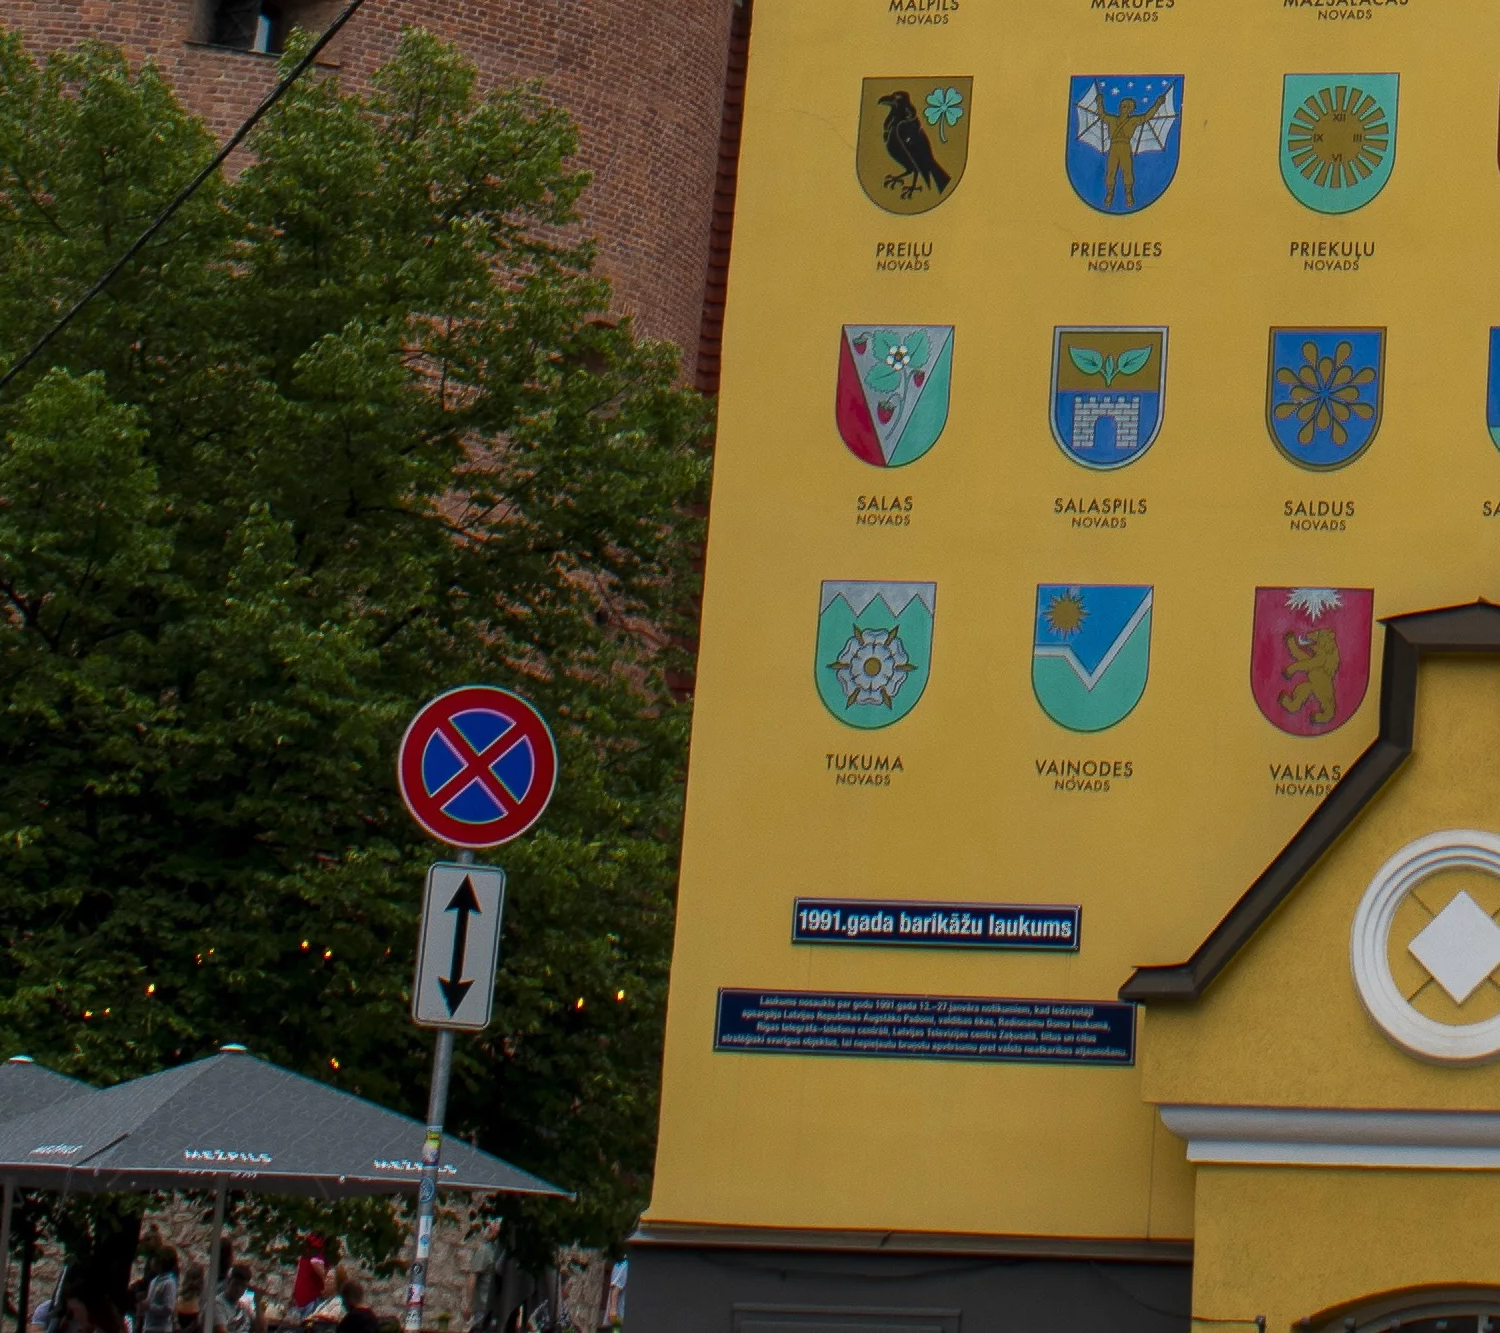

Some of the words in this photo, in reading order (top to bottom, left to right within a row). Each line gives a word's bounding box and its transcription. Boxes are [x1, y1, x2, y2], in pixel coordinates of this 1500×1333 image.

[875, 241, 933, 262] PREIĻU
[1070, 241, 1163, 258] PRIEKULES
[1289, 241, 1375, 262] PRIEKUĻU
[856, 495, 914, 513] SALAS
[1053, 497, 1148, 515] SALASPILS
[1283, 499, 1355, 517] SALDUS
[825, 753, 905, 772] TUKUMA
[1035, 759, 1134, 782] VAIŅODES
[1268, 762, 1342, 783] VALKAS
[799, 908, 895, 936] 1991.gada
[899, 911, 984, 936] barikāžu
[987, 913, 1074, 938] laukums
